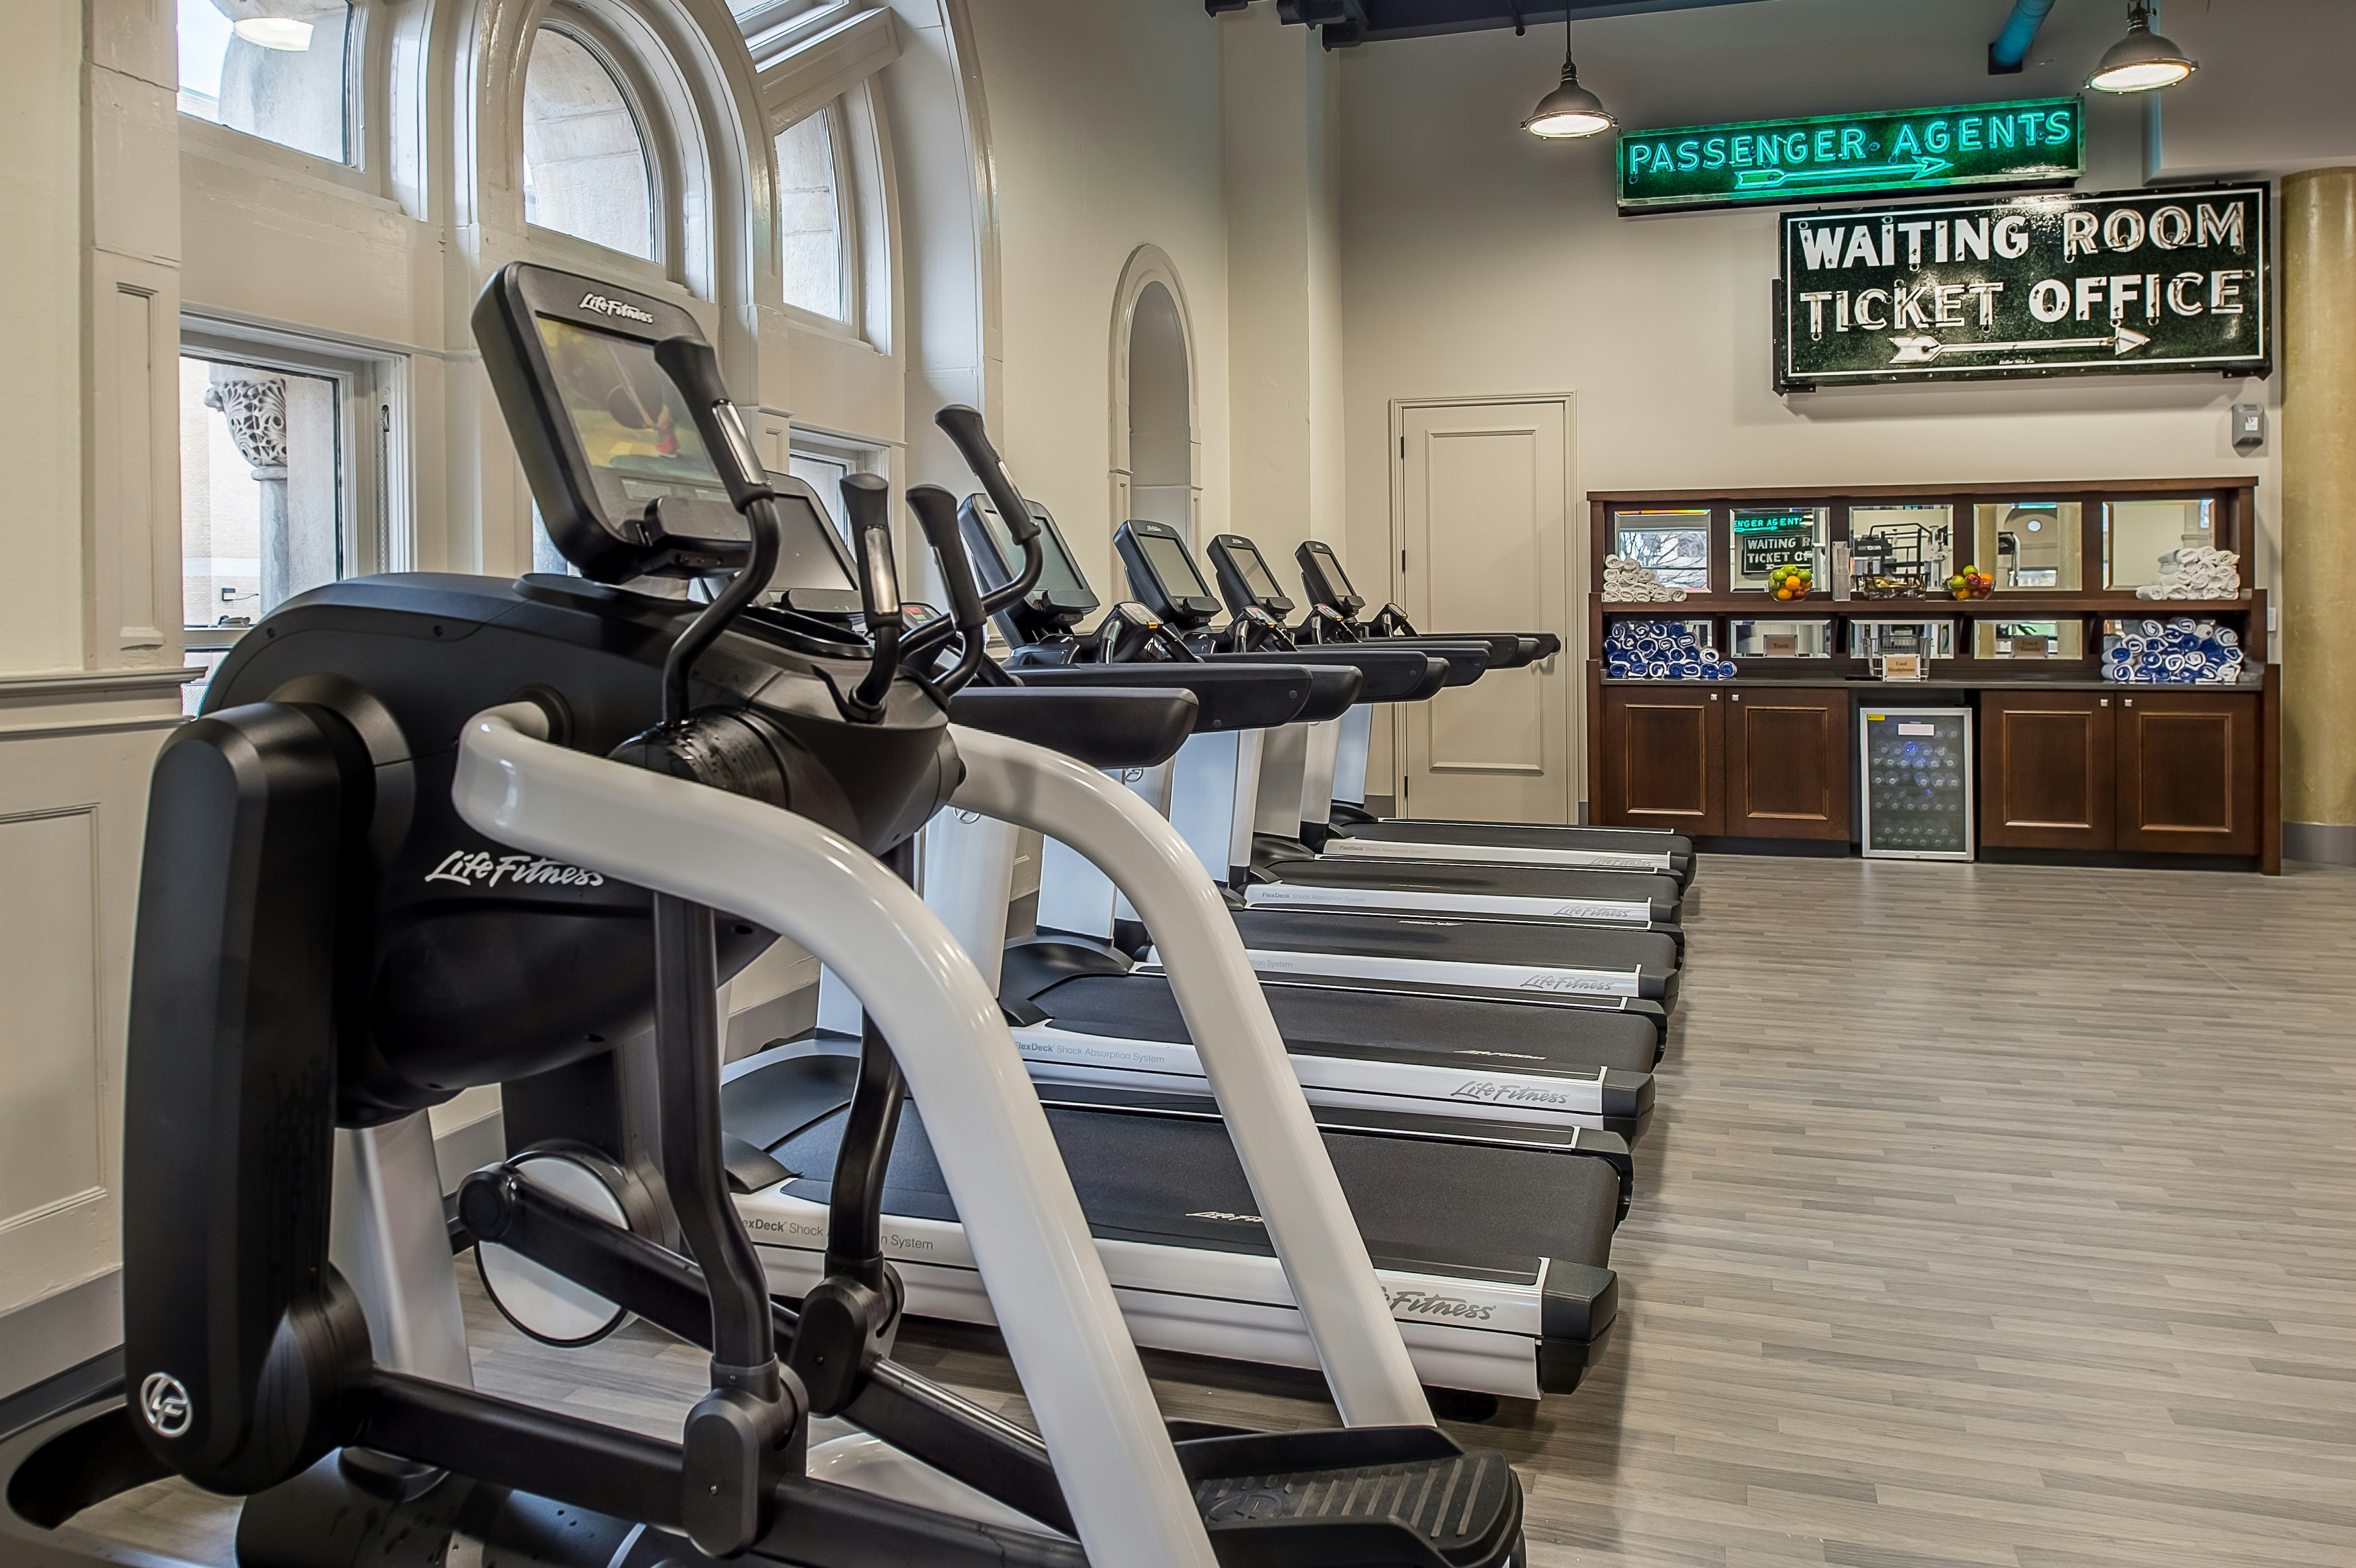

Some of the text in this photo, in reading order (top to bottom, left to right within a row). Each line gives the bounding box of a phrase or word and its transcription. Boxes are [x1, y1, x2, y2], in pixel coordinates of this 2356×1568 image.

[1629, 110, 2071, 174] PASSENGER AGENTS
[1800, 202, 2244, 270] WAITING ROOM
[1800, 270, 2244, 333] TICKET OFFICE
[1747, 538, 1796, 549] WAITING
[1747, 552, 1790, 563] TICKET
[1266, 960, 1292, 968] System
[1057, 1045, 1082, 1055] Shock
[1084, 1048, 1131, 1059] Absorption
[1133, 1053, 1164, 1063] System
[742, 1219, 784, 1232] exDeck
[789, 1222, 824, 1236] Shock
[891, 1235, 933, 1250] System
